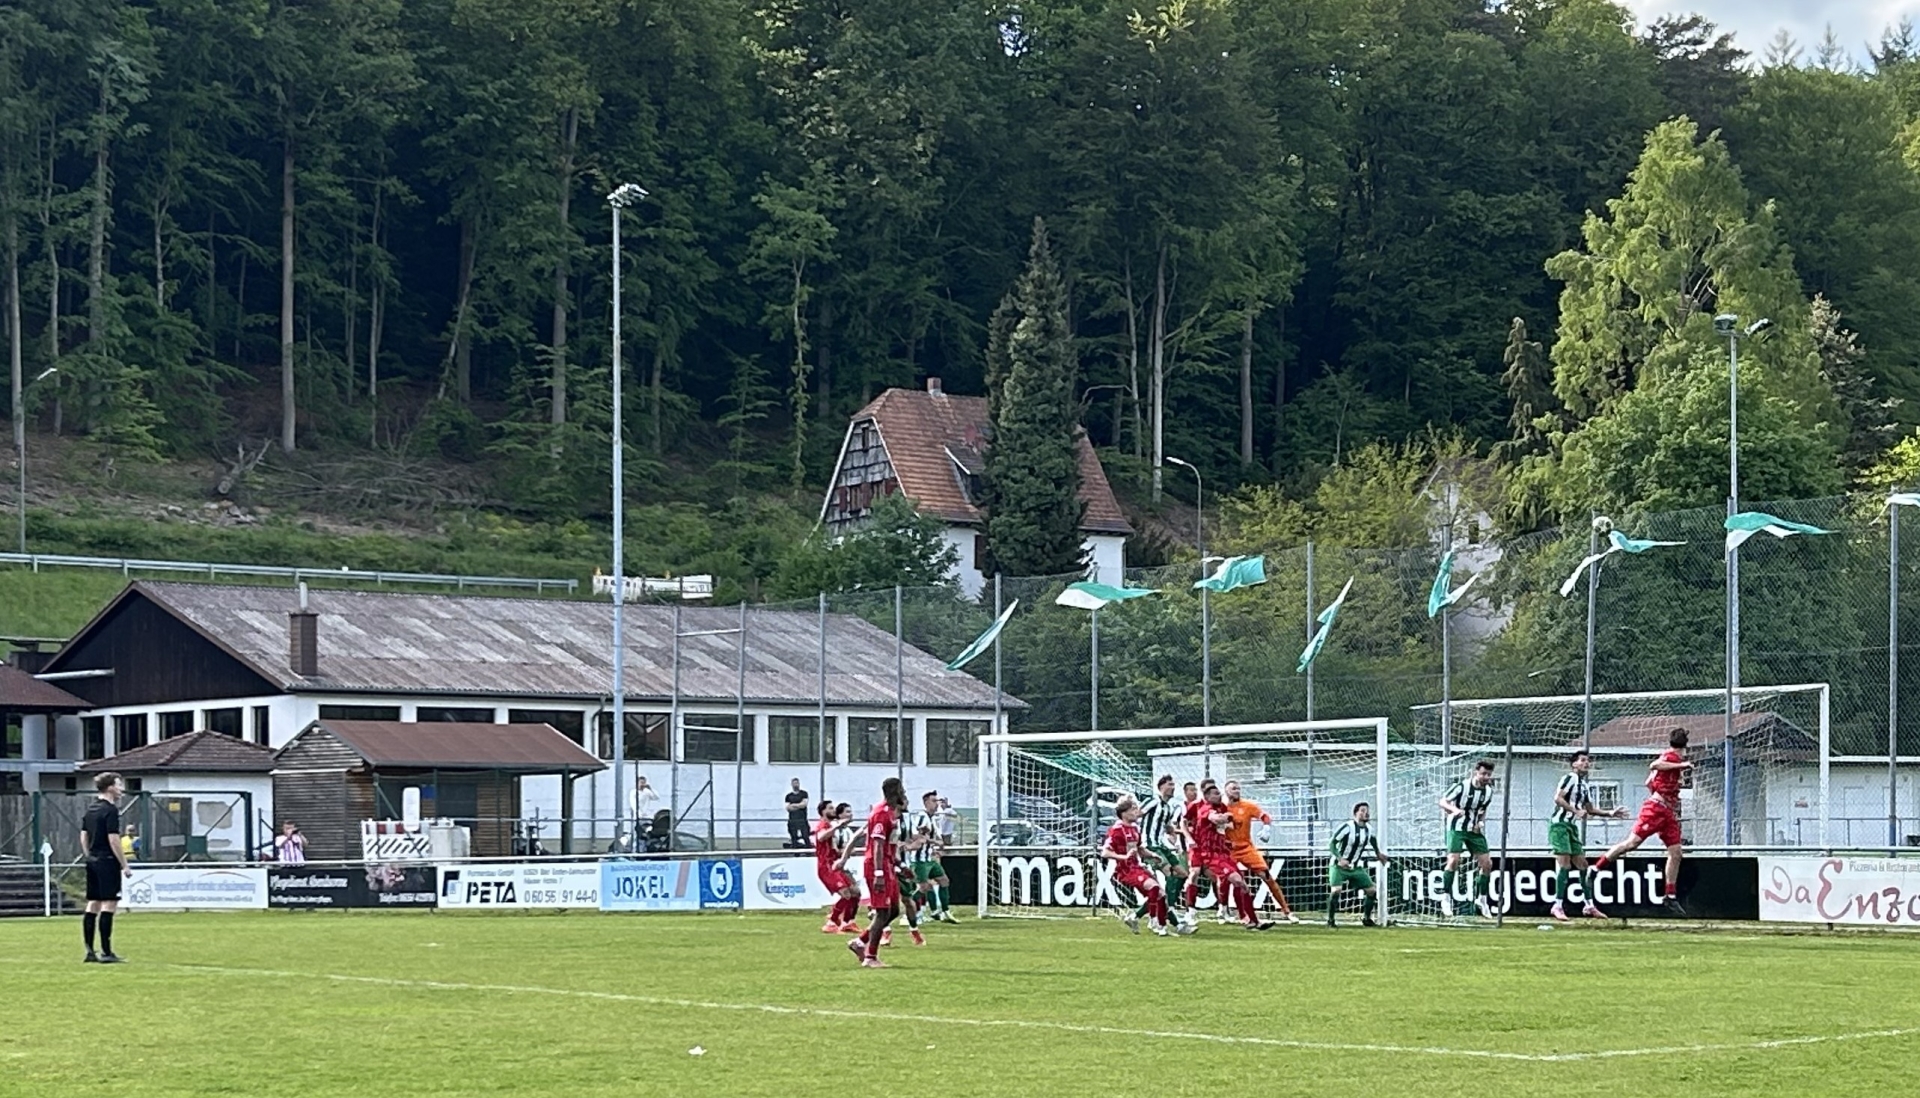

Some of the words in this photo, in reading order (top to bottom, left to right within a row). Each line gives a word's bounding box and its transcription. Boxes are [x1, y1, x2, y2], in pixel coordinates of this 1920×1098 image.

[466, 881, 517, 904] PETA
[1402, 869, 1474, 902] neu
[1488, 859, 1664, 914] gedacht
